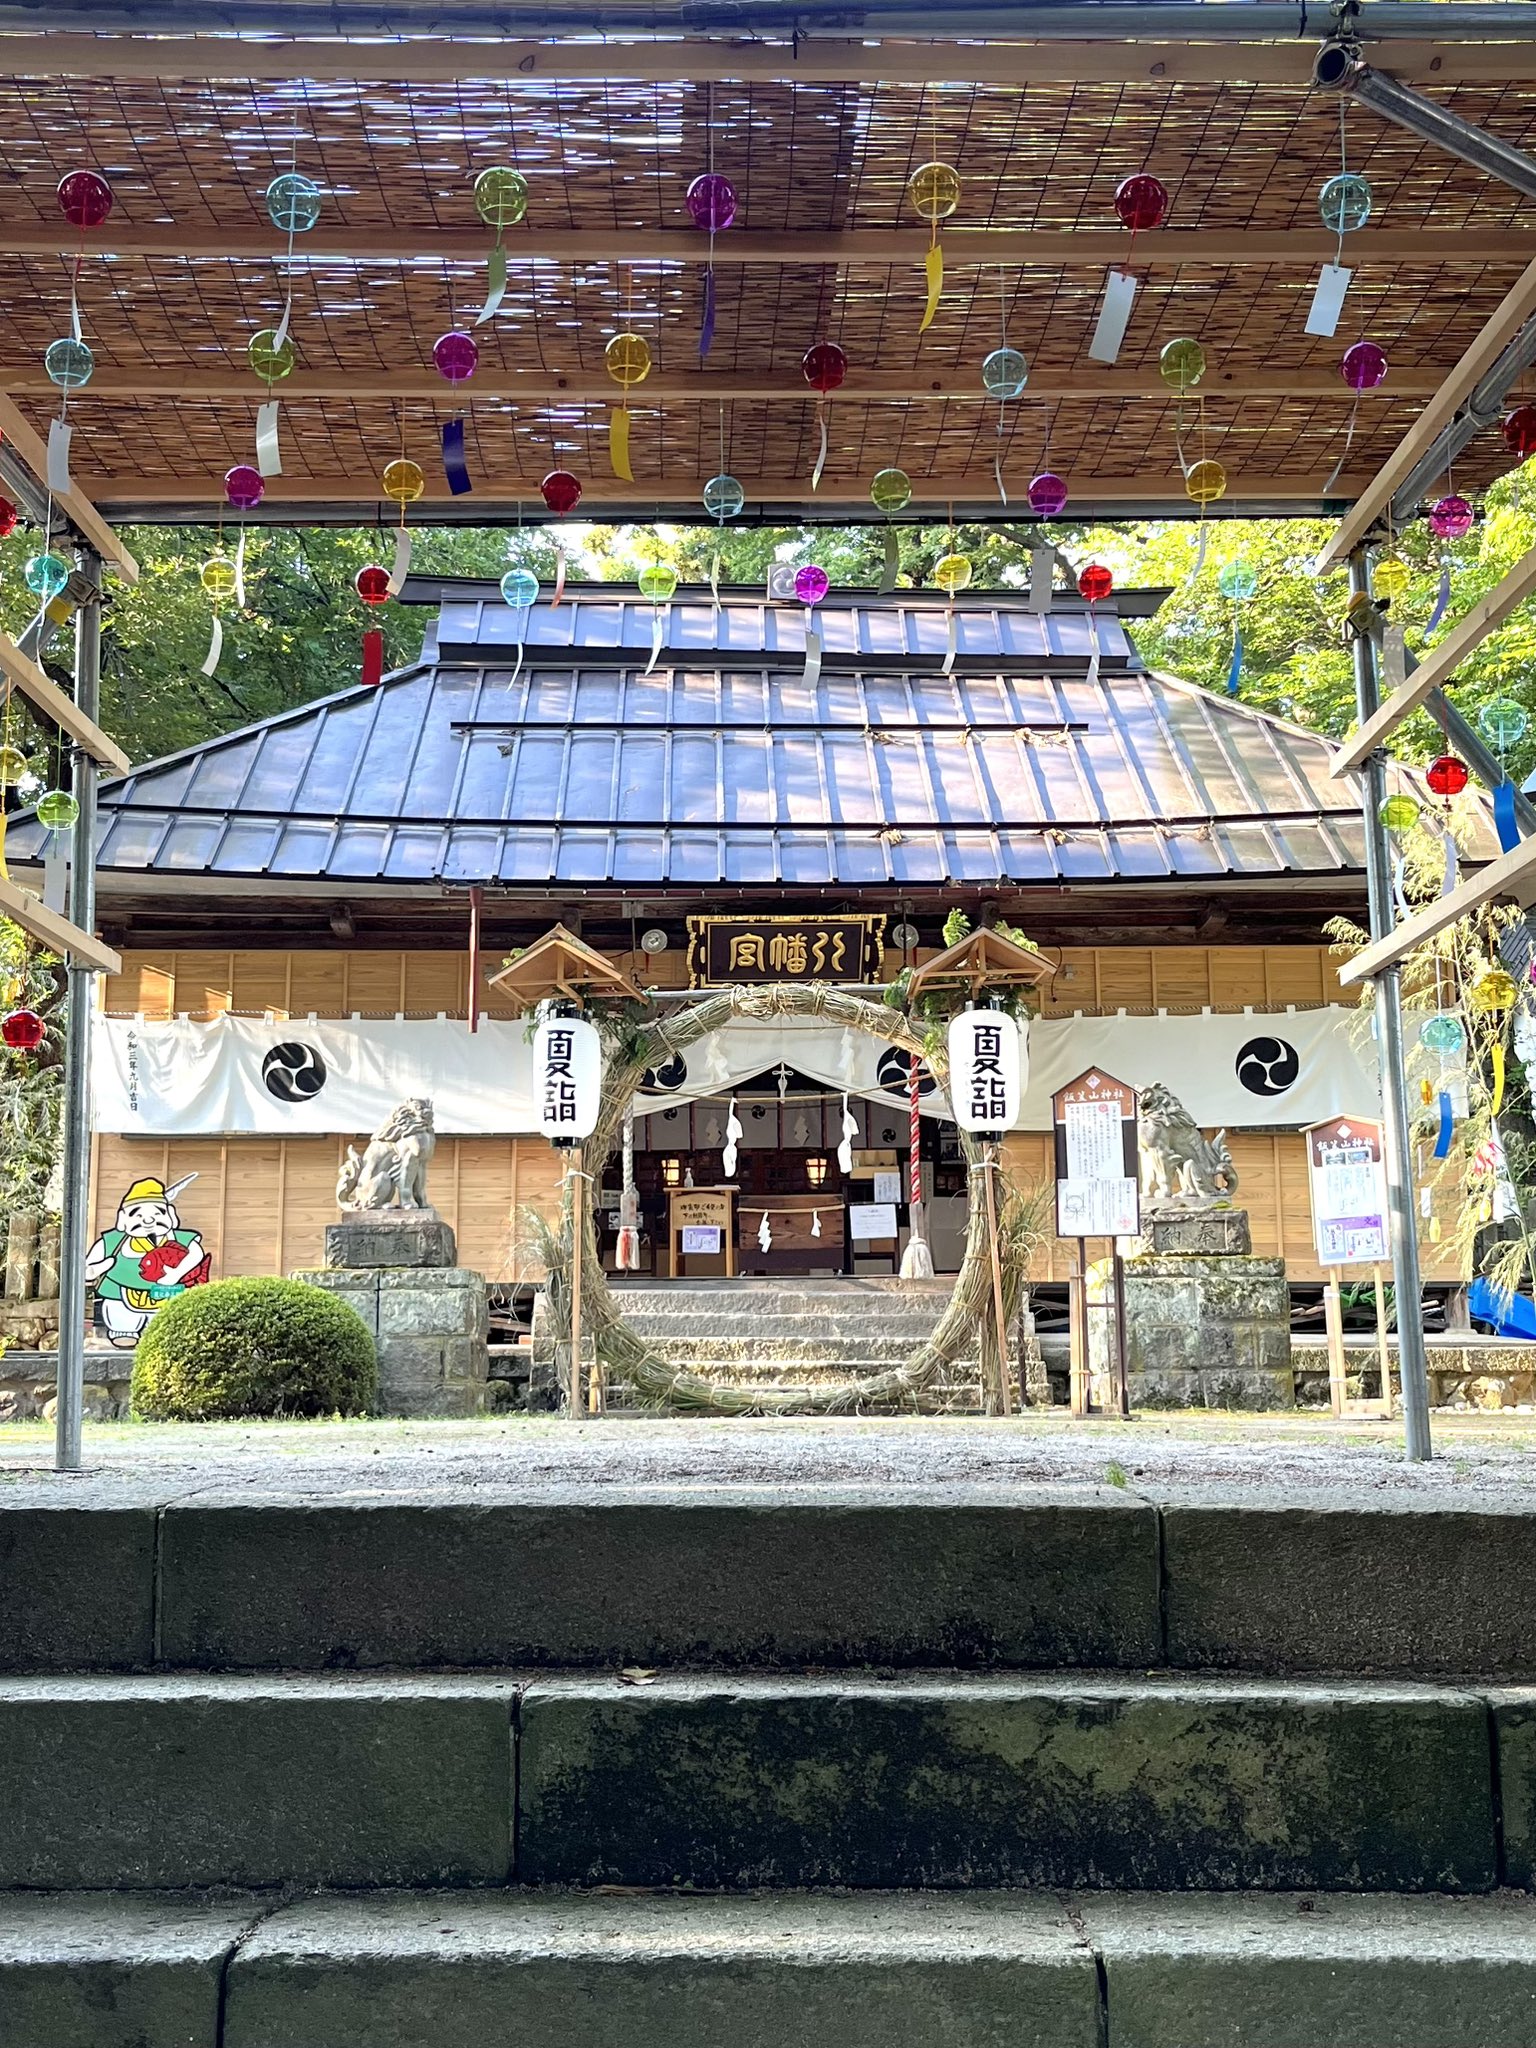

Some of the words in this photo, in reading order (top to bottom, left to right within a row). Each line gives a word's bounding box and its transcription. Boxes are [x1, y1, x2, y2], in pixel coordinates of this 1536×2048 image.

[729, 931, 846, 974] 八幡宮
[127, 1030, 138, 1112] 令和三年九月吉日
[544, 1029, 576, 1122] 夏詣
[972, 1025, 1006, 1119] 夏詣
[1160, 1222, 1217, 1246] 奉納
